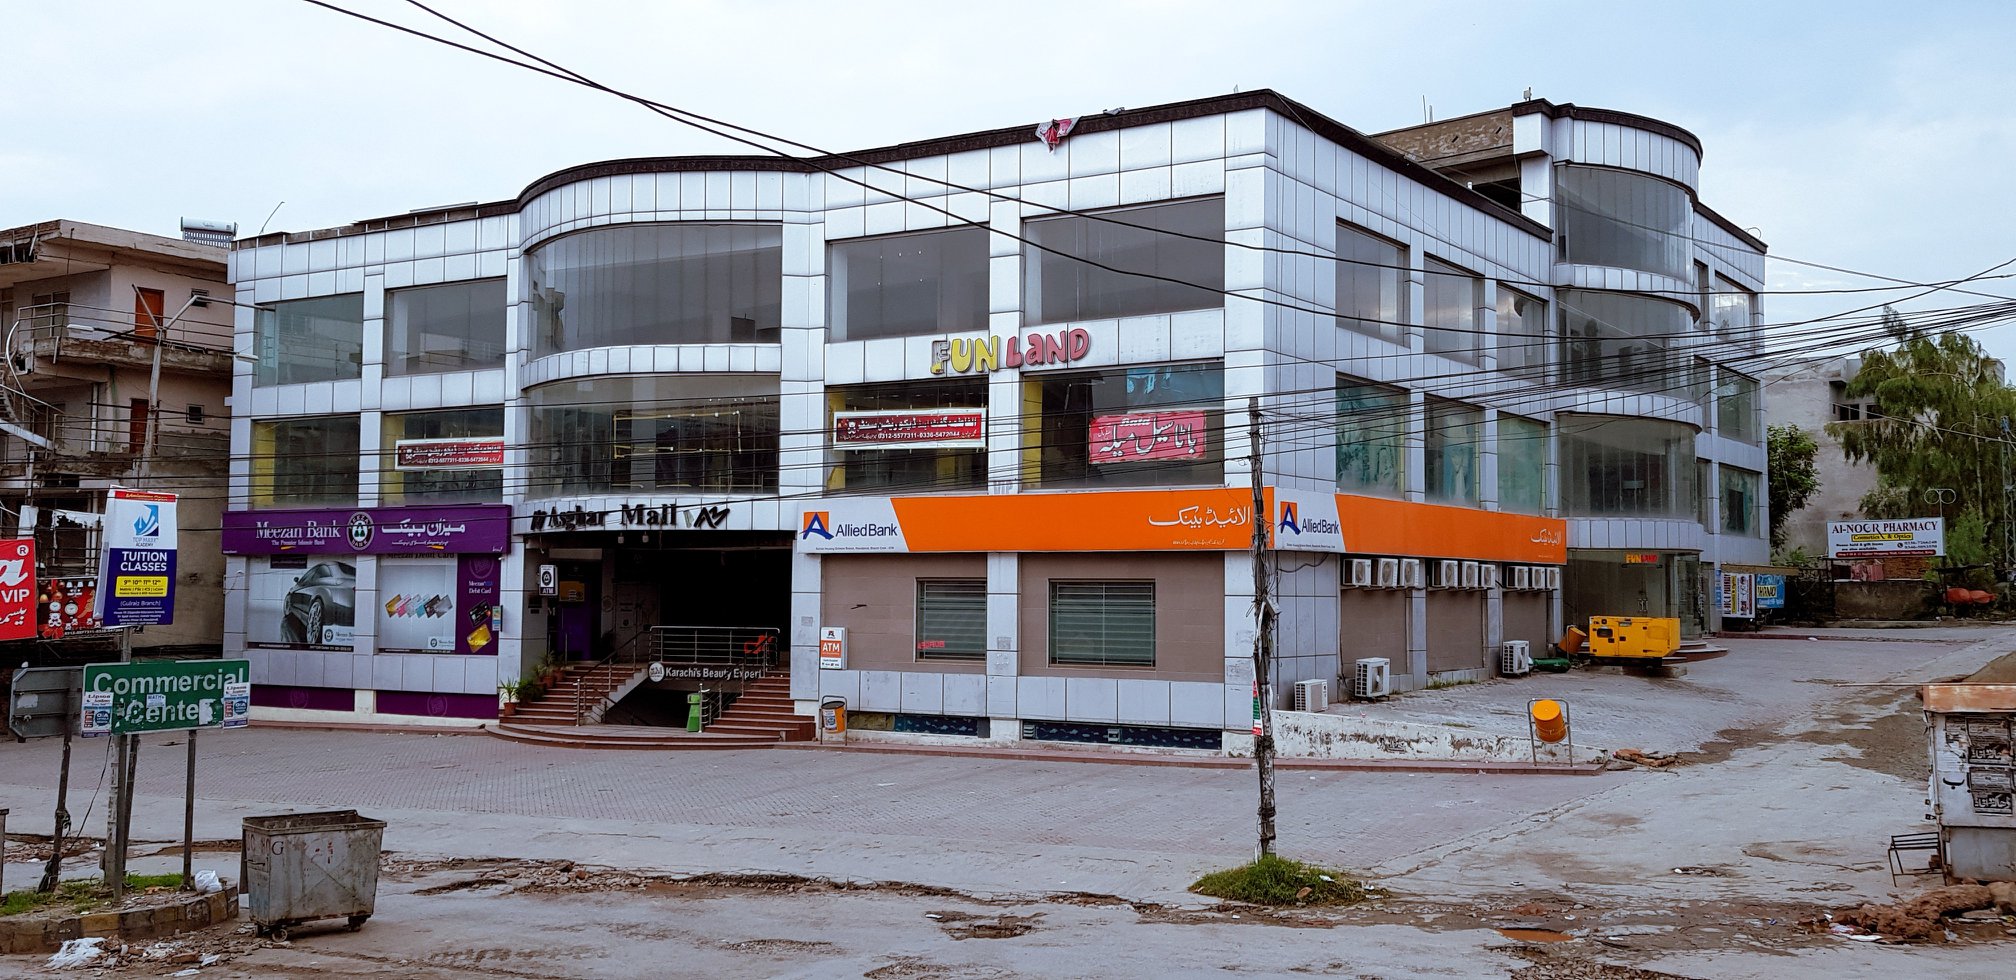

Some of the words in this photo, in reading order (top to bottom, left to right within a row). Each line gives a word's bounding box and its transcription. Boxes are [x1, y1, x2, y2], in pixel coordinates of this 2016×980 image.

[547, 504, 608, 532] Asghar
[620, 503, 677, 527] Mall
[256, 521, 303, 539] Meezan
[306, 520, 341, 538] Bank
[1883, 522, 1938, 532] PHARMACY
[122, 551, 168, 562] TUITION
[120, 562, 167, 572] CLASSES
[1, 589, 30, 603] VIP
[822, 642, 840, 652] ATM
[665, 667, 701, 678] Karachi's
[702, 668, 731, 681] Beauty
[93, 668, 244, 695] Commercial
[125, 699, 203, 725] Cente
[271, 840, 284, 856] G
